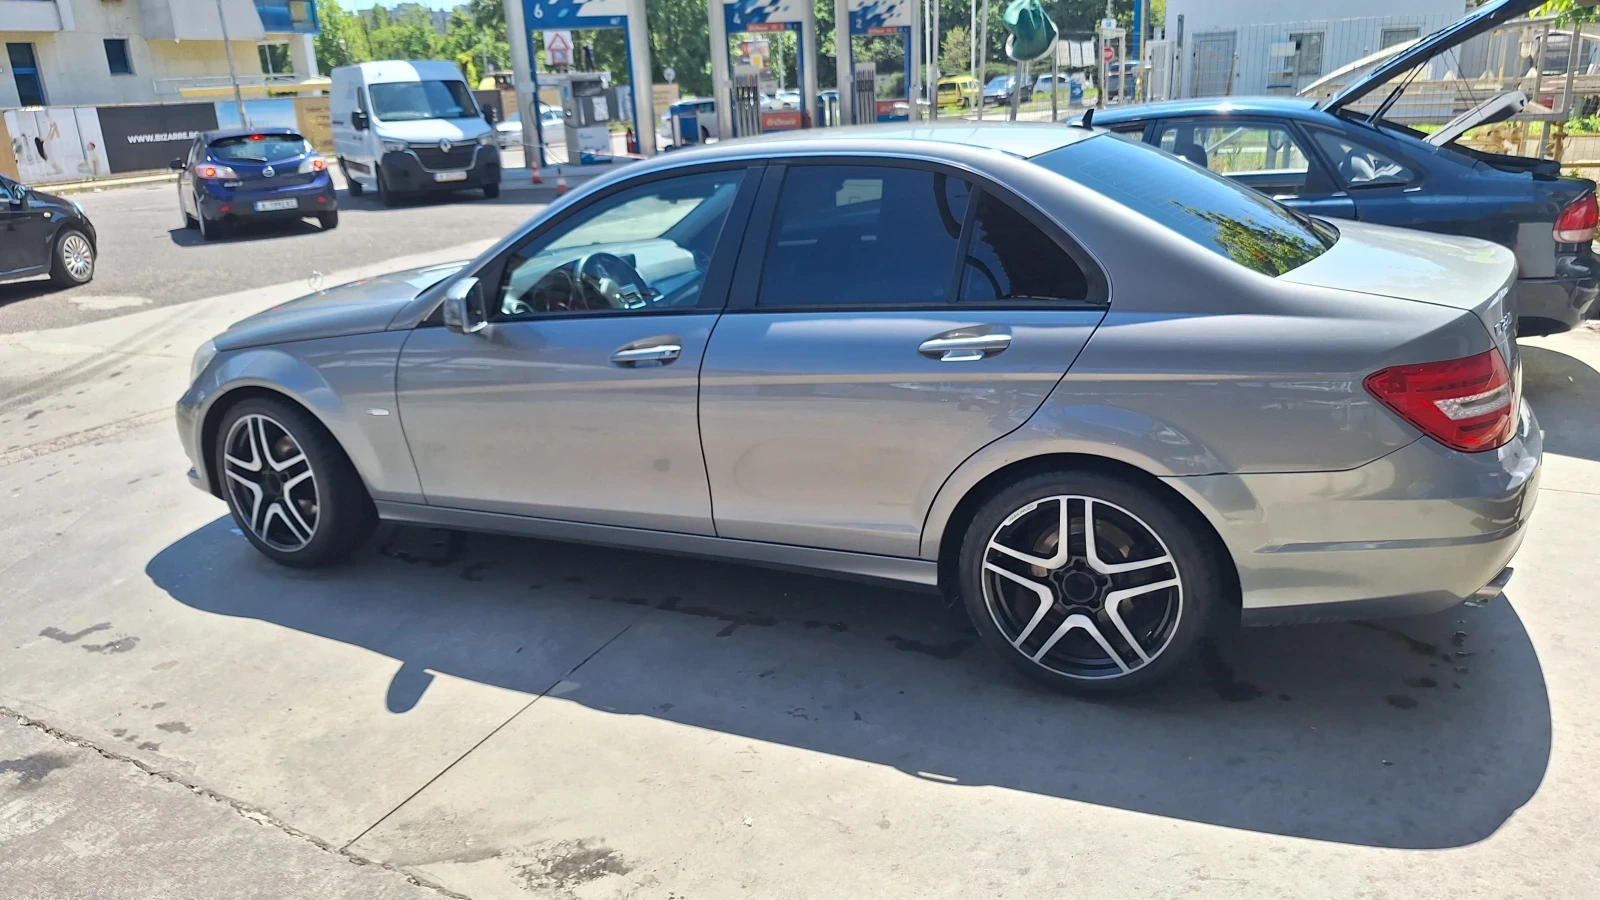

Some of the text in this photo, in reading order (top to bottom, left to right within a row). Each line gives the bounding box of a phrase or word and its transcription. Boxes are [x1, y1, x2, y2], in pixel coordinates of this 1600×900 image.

[533, 3, 544, 19] 6
[732, 12, 742, 24] 4
[855, 18, 863, 29] 2
